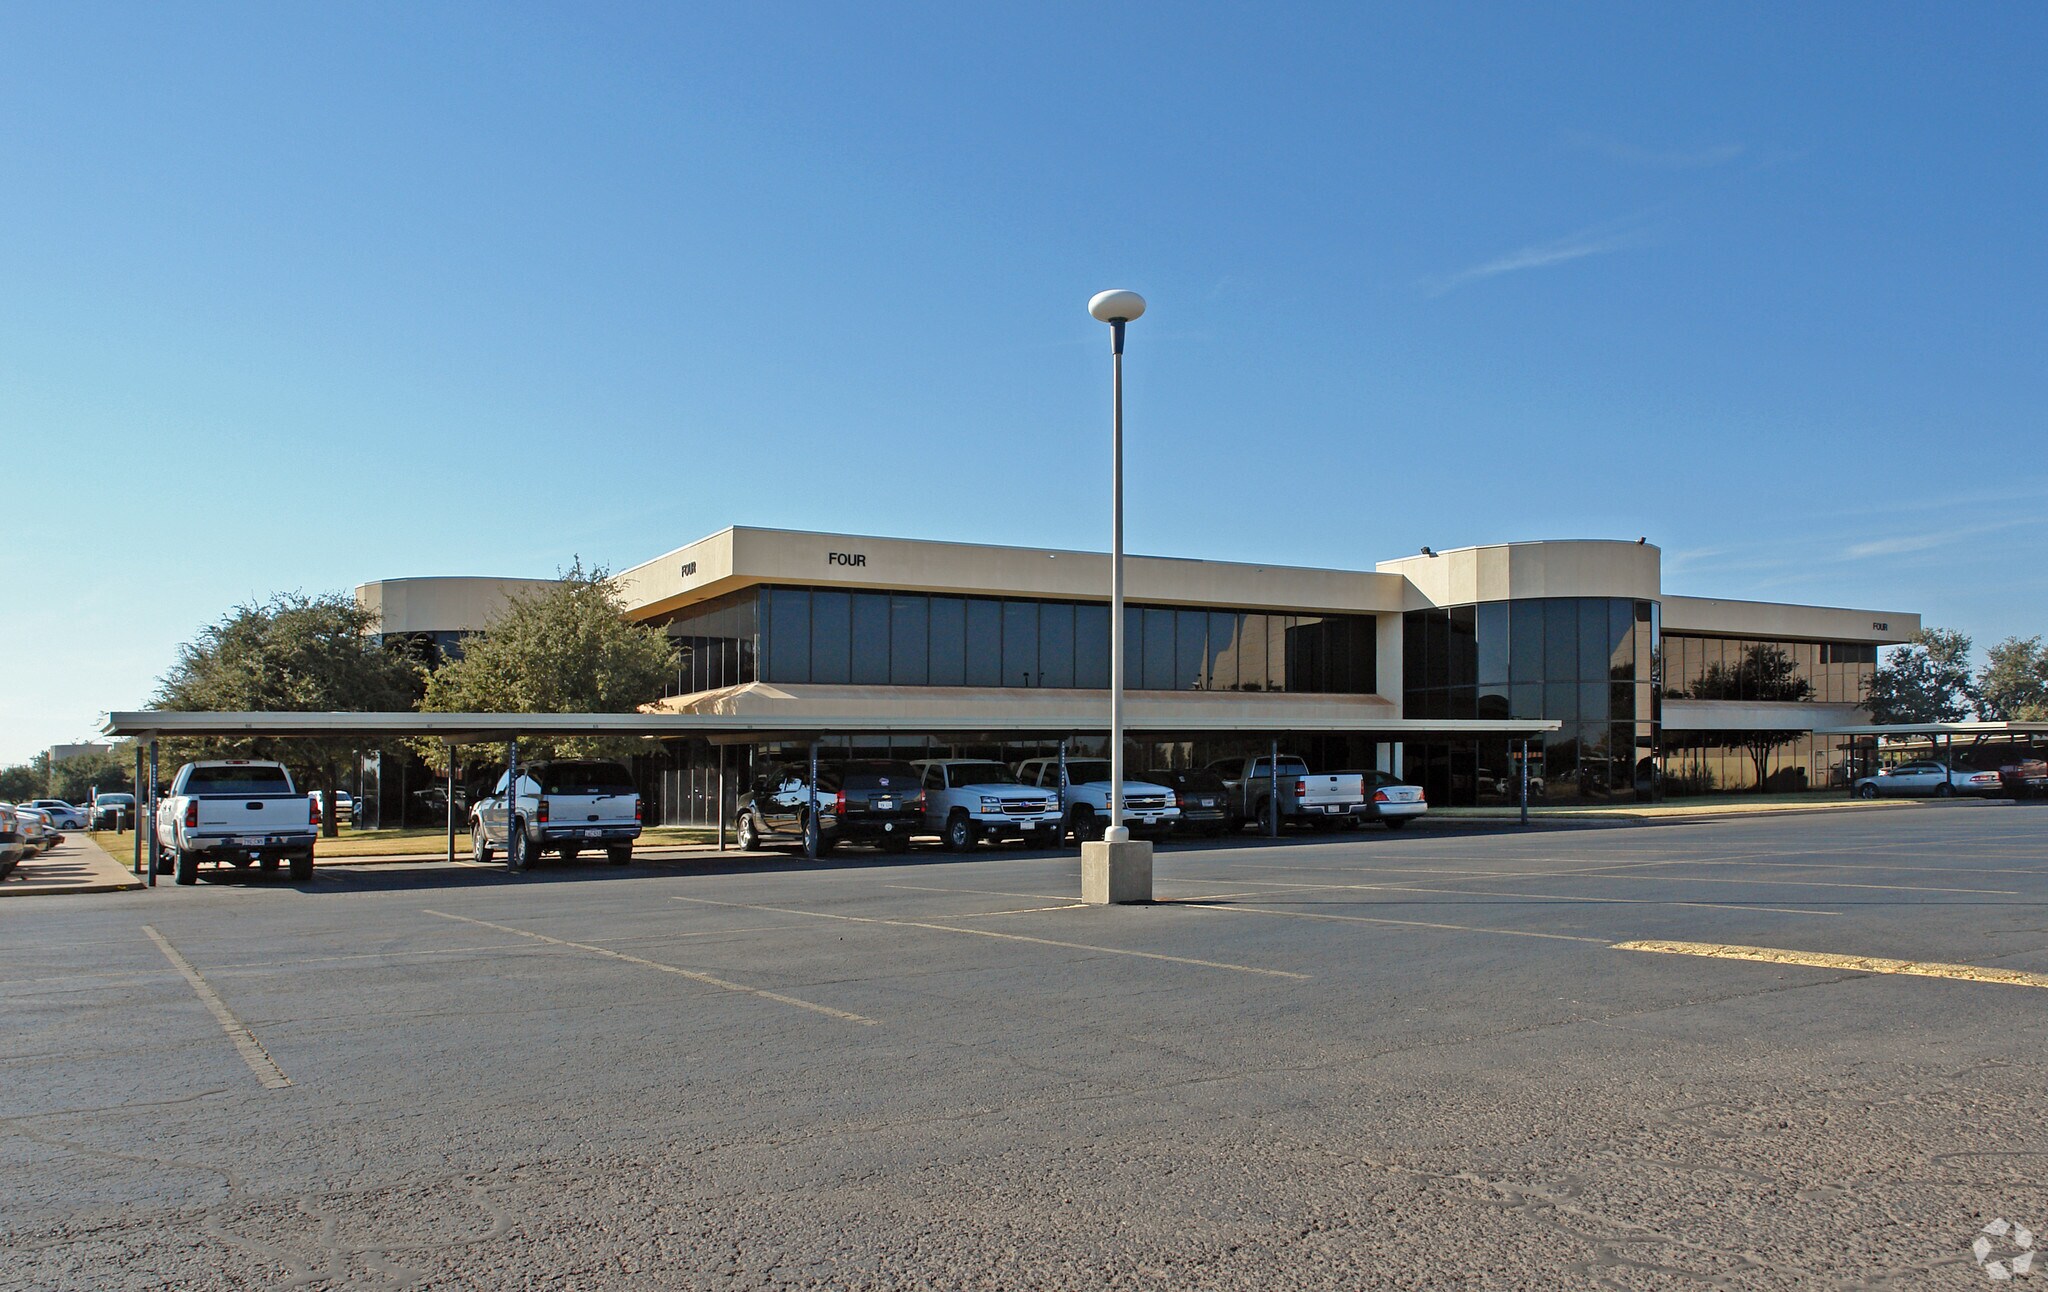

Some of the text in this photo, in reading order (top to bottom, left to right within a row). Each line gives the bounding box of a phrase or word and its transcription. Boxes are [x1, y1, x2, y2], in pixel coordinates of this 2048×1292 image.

[829, 552, 866, 567] FOUR
[681, 561, 697, 578] FOUR
[1872, 622, 1888, 631] FOUR
